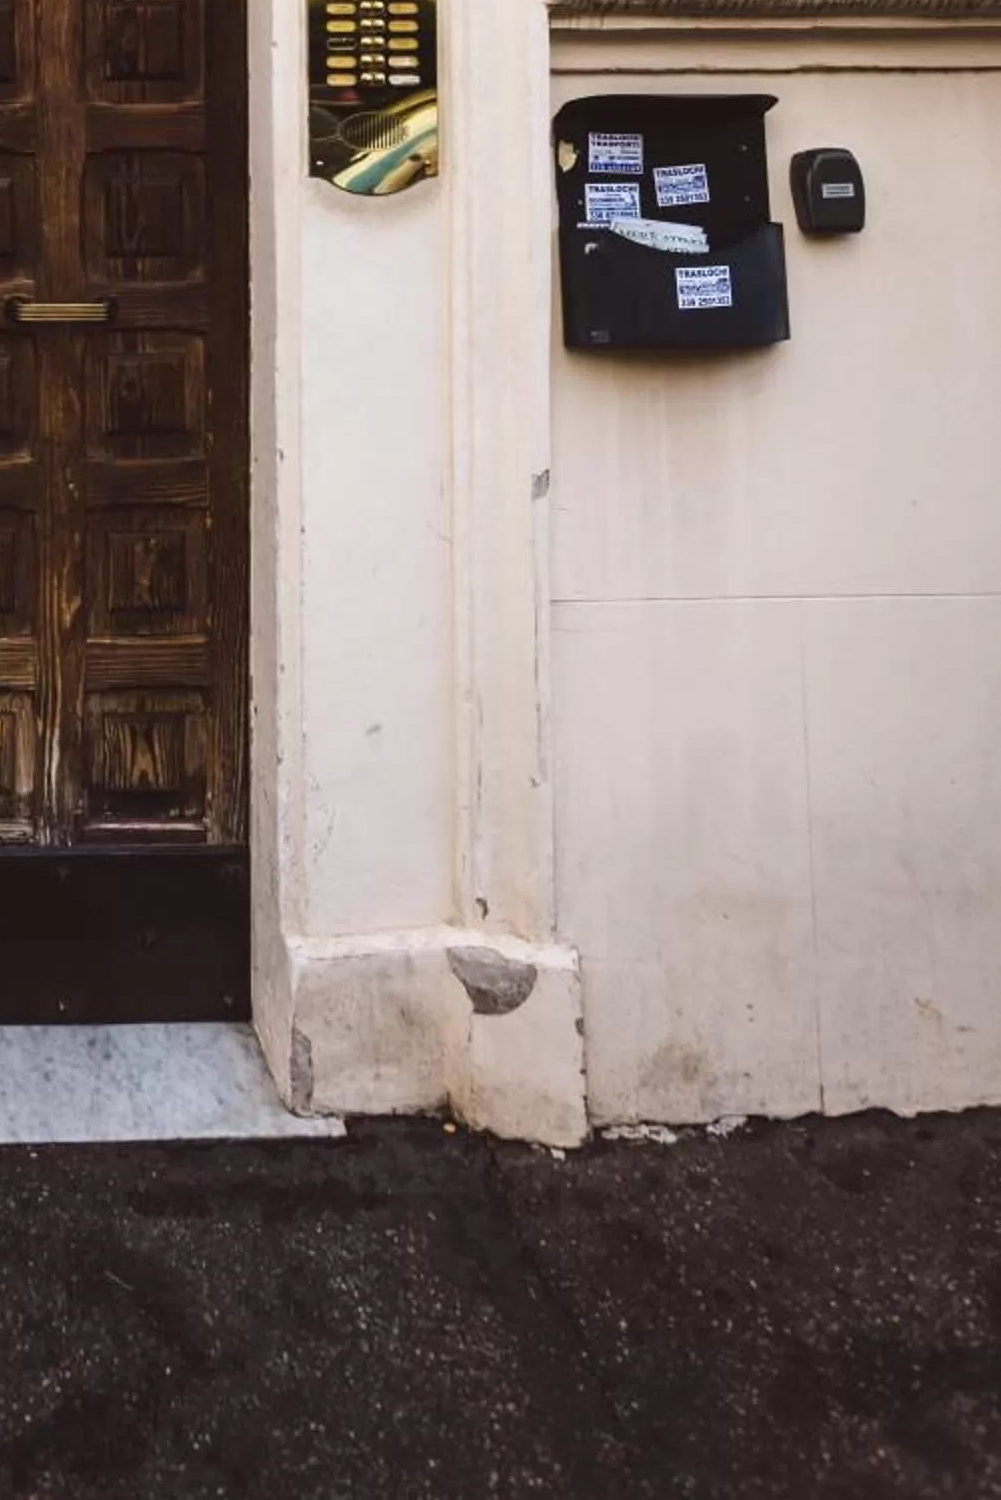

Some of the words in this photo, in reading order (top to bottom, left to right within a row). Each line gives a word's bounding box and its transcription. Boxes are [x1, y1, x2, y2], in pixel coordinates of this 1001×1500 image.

[656, 166, 704, 177] TRASLOCHI
[589, 185, 637, 193] TRASLOCHI
[678, 267, 728, 278] TRASLOCHI
